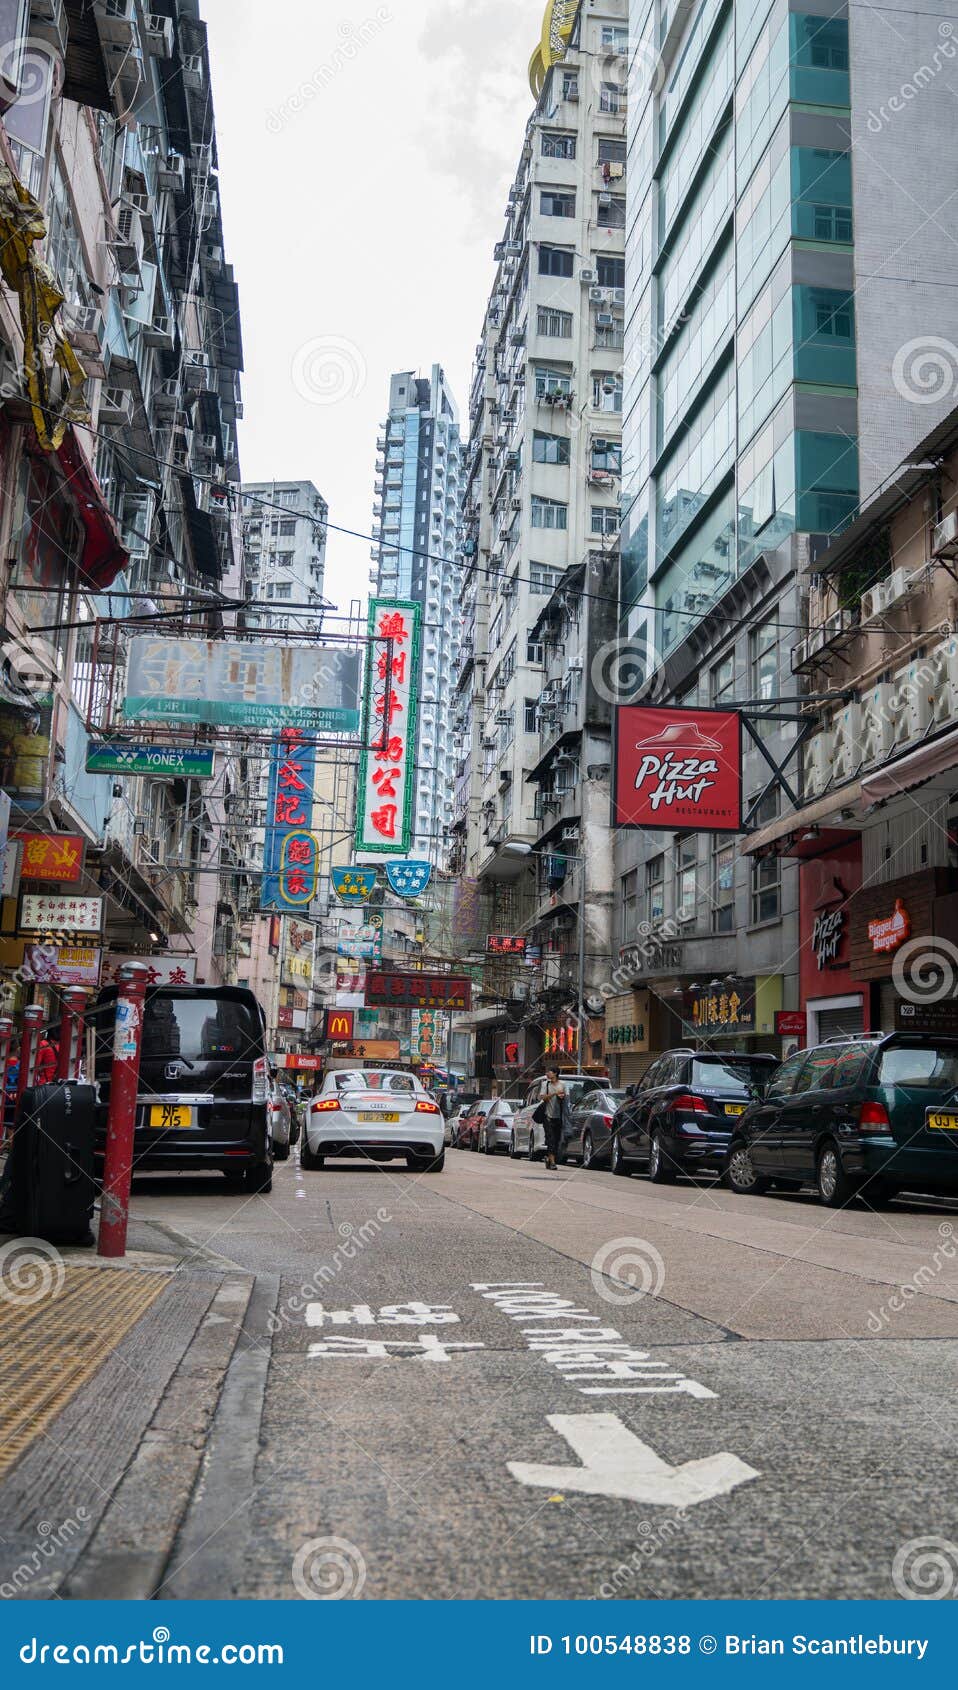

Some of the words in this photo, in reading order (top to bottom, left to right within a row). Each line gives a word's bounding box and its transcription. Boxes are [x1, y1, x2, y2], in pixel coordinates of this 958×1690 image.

[295, 719, 332, 729] ZIPPER
[371, 612, 408, 838] 澳洲牛奶公司
[146, 753, 184, 766] YONEX
[634, 751, 719, 789] Pizza
[649, 778, 715, 810] Hut
[675, 807, 733, 817] RESTAURANT
[812, 909, 843, 951] Pizza
[868, 921, 892, 938] Bigger
[873, 933, 897, 950] Burger
[816, 931, 842, 971] Hut
[163, 1106, 178, 1116] NF
[727, 1105, 739, 1114] JE
[161, 1116, 181, 1127] 715
[935, 1115, 950, 1126] UJ
[468, 1282, 602, 1322] LOOK
[519, 1327, 720, 1399] RIGHT
